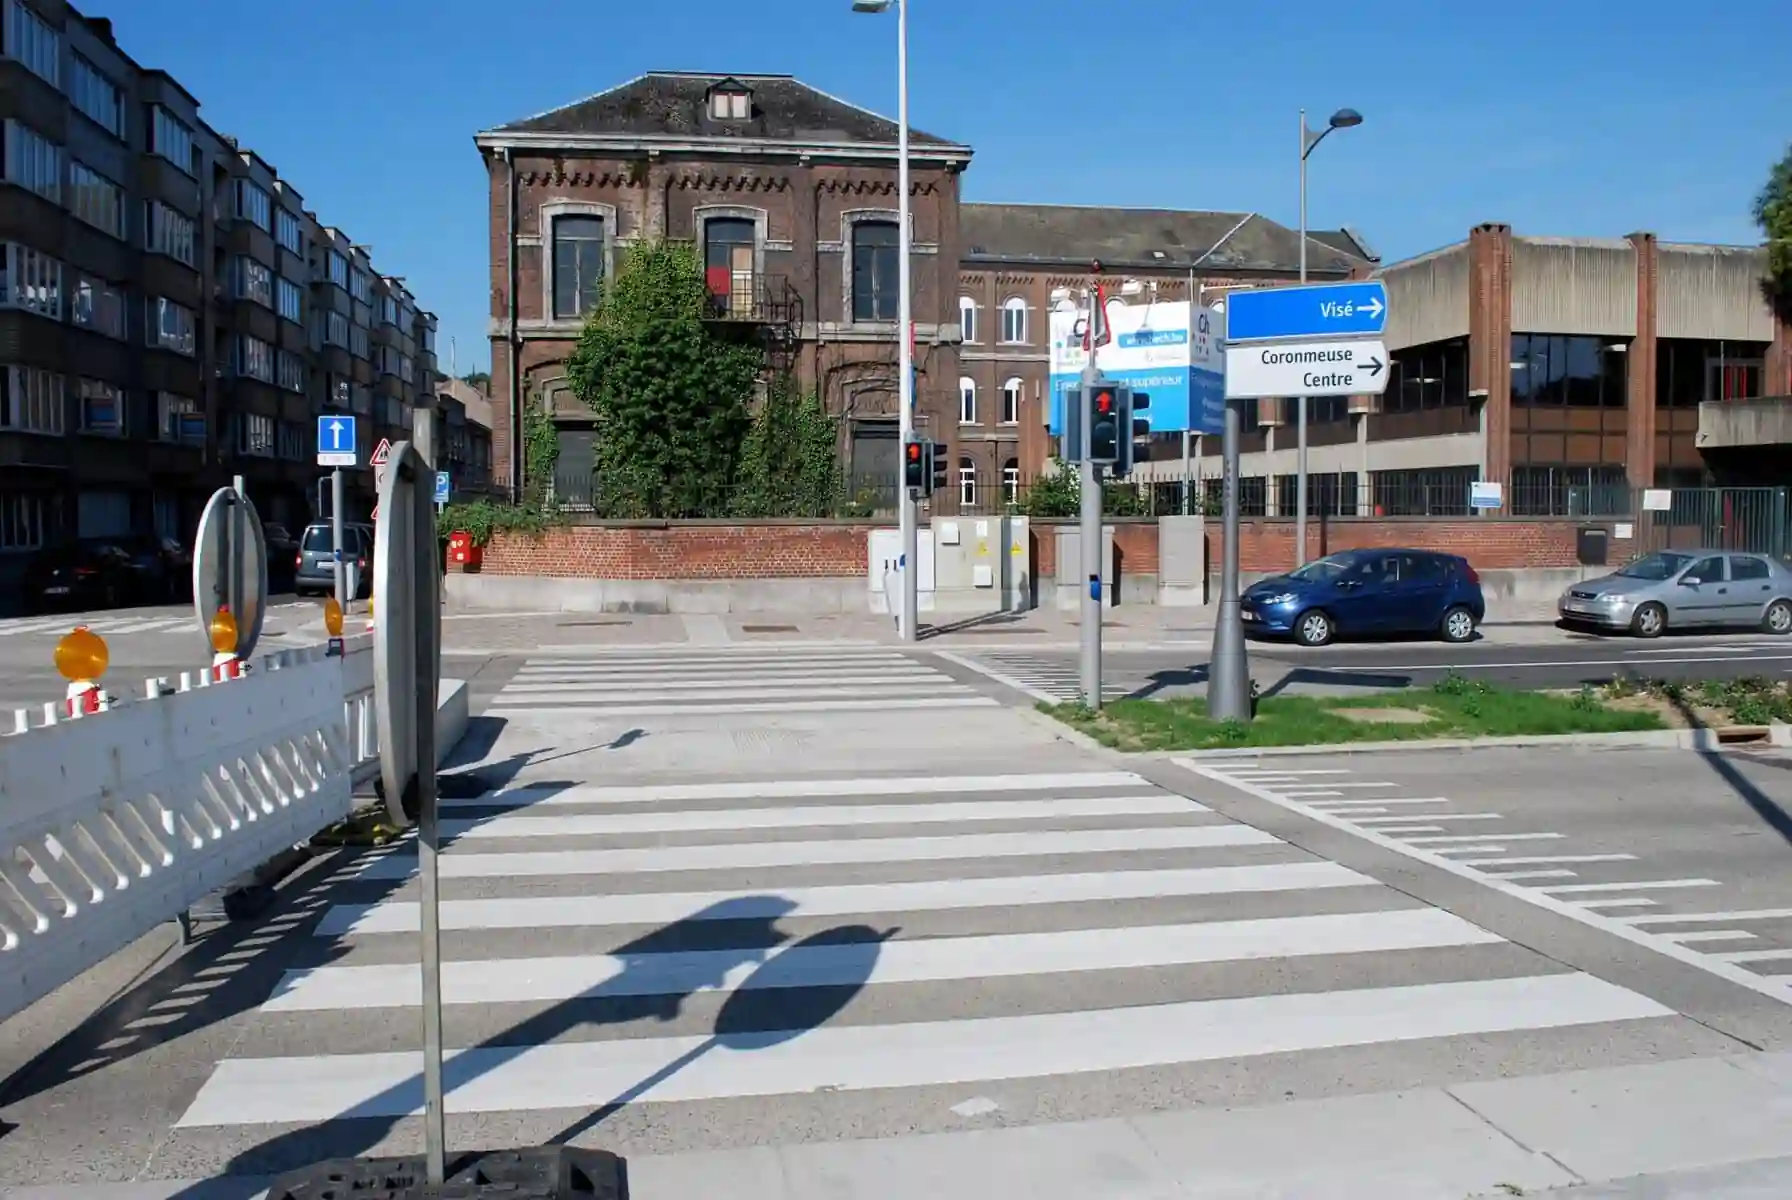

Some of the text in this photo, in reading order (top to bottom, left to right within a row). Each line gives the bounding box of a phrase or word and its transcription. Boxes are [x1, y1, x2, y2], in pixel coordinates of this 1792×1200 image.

[1320, 301, 1352, 318] Visé
[1261, 350, 1352, 364] Coronmeuse
[1304, 373, 1352, 387] Centre
[436, 475, 446, 491] P
